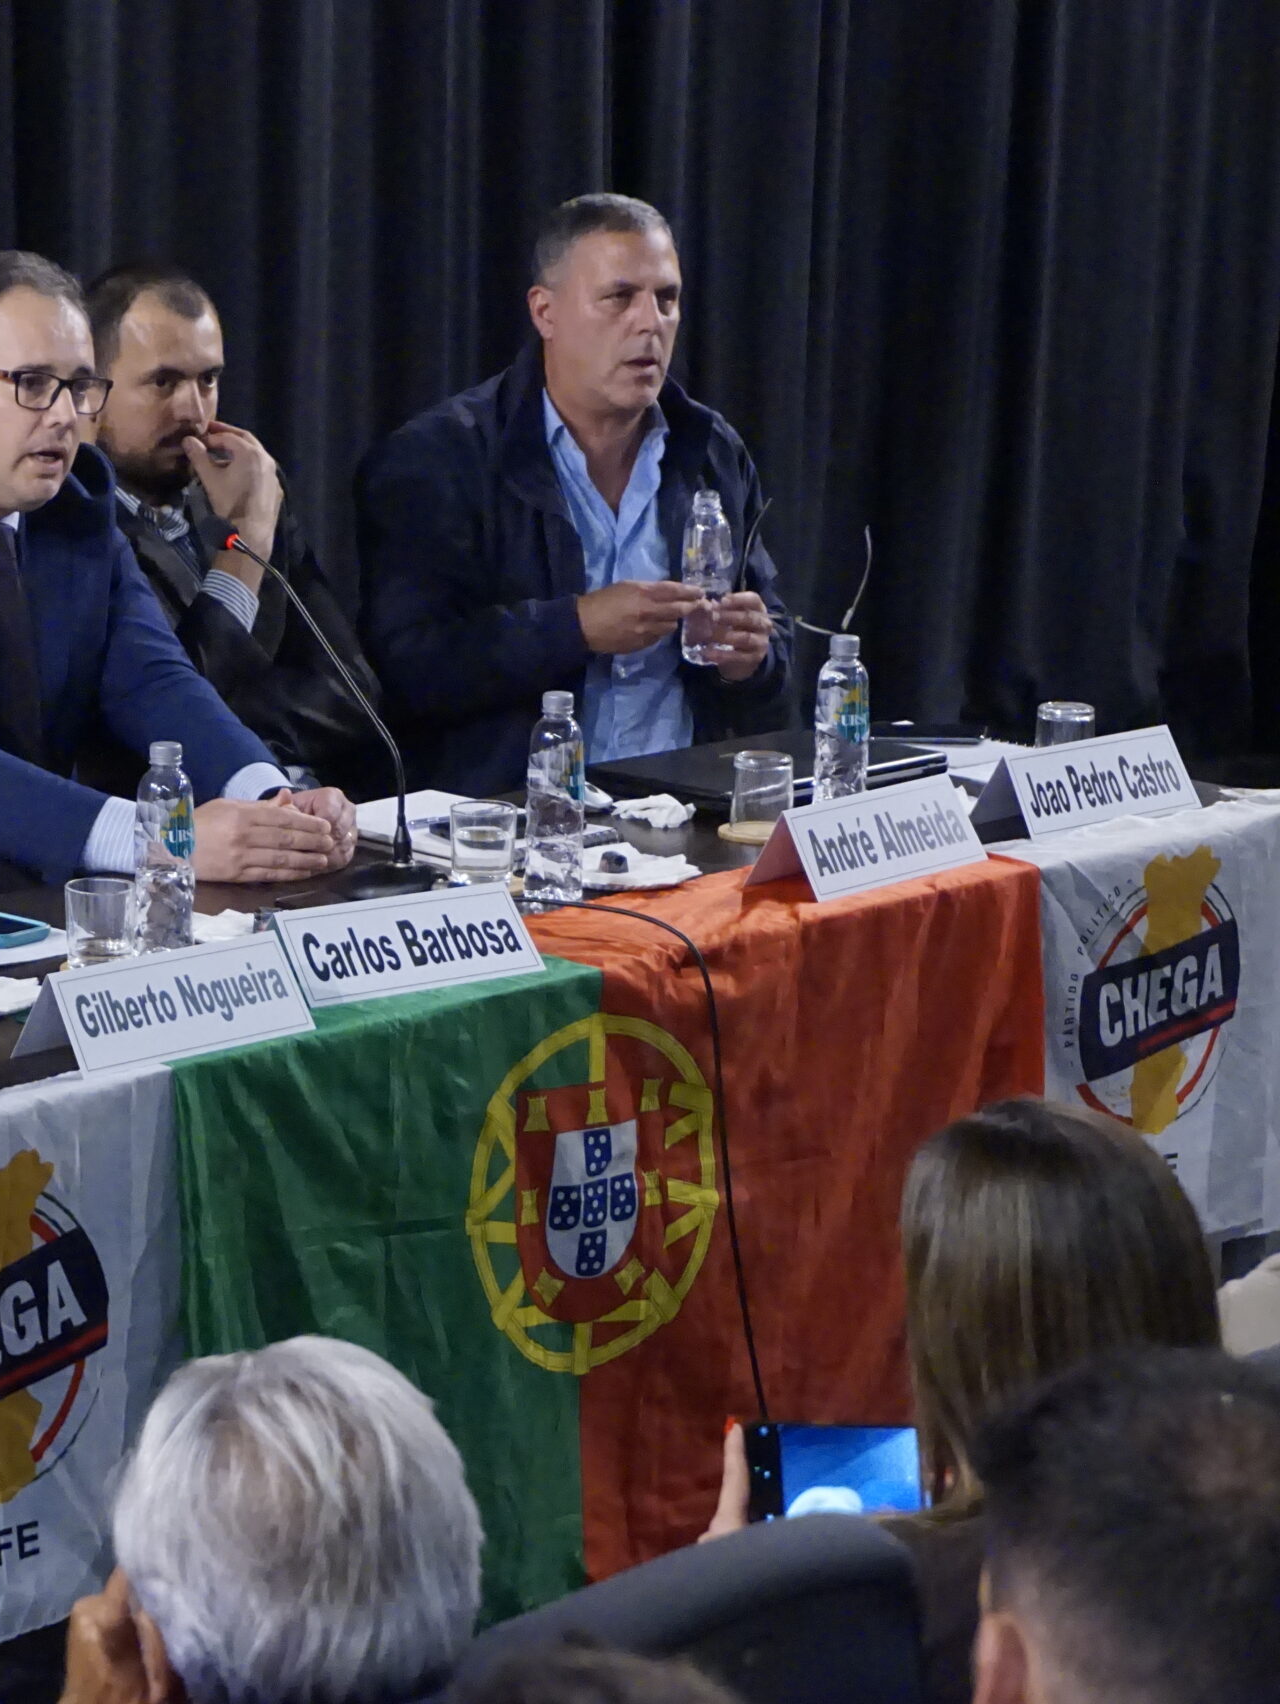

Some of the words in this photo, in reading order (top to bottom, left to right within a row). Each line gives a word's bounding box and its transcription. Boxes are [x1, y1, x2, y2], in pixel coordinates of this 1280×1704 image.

[1026, 772, 1071, 818] Joao
[1064, 761, 1123, 810] Pedro
[1118, 752, 1182, 799] Castro
[807, 817, 879, 877] André
[874, 800, 969, 860] Almeida
[302, 926, 402, 982] Carlos
[395, 914, 522, 967] Barbosa
[75, 982, 177, 1038] Gilberto
[174, 962, 289, 1022] Nogueira
[1063, 972, 1079, 1049] PARTIDO
[1099, 943, 1223, 1047] CHEGA
